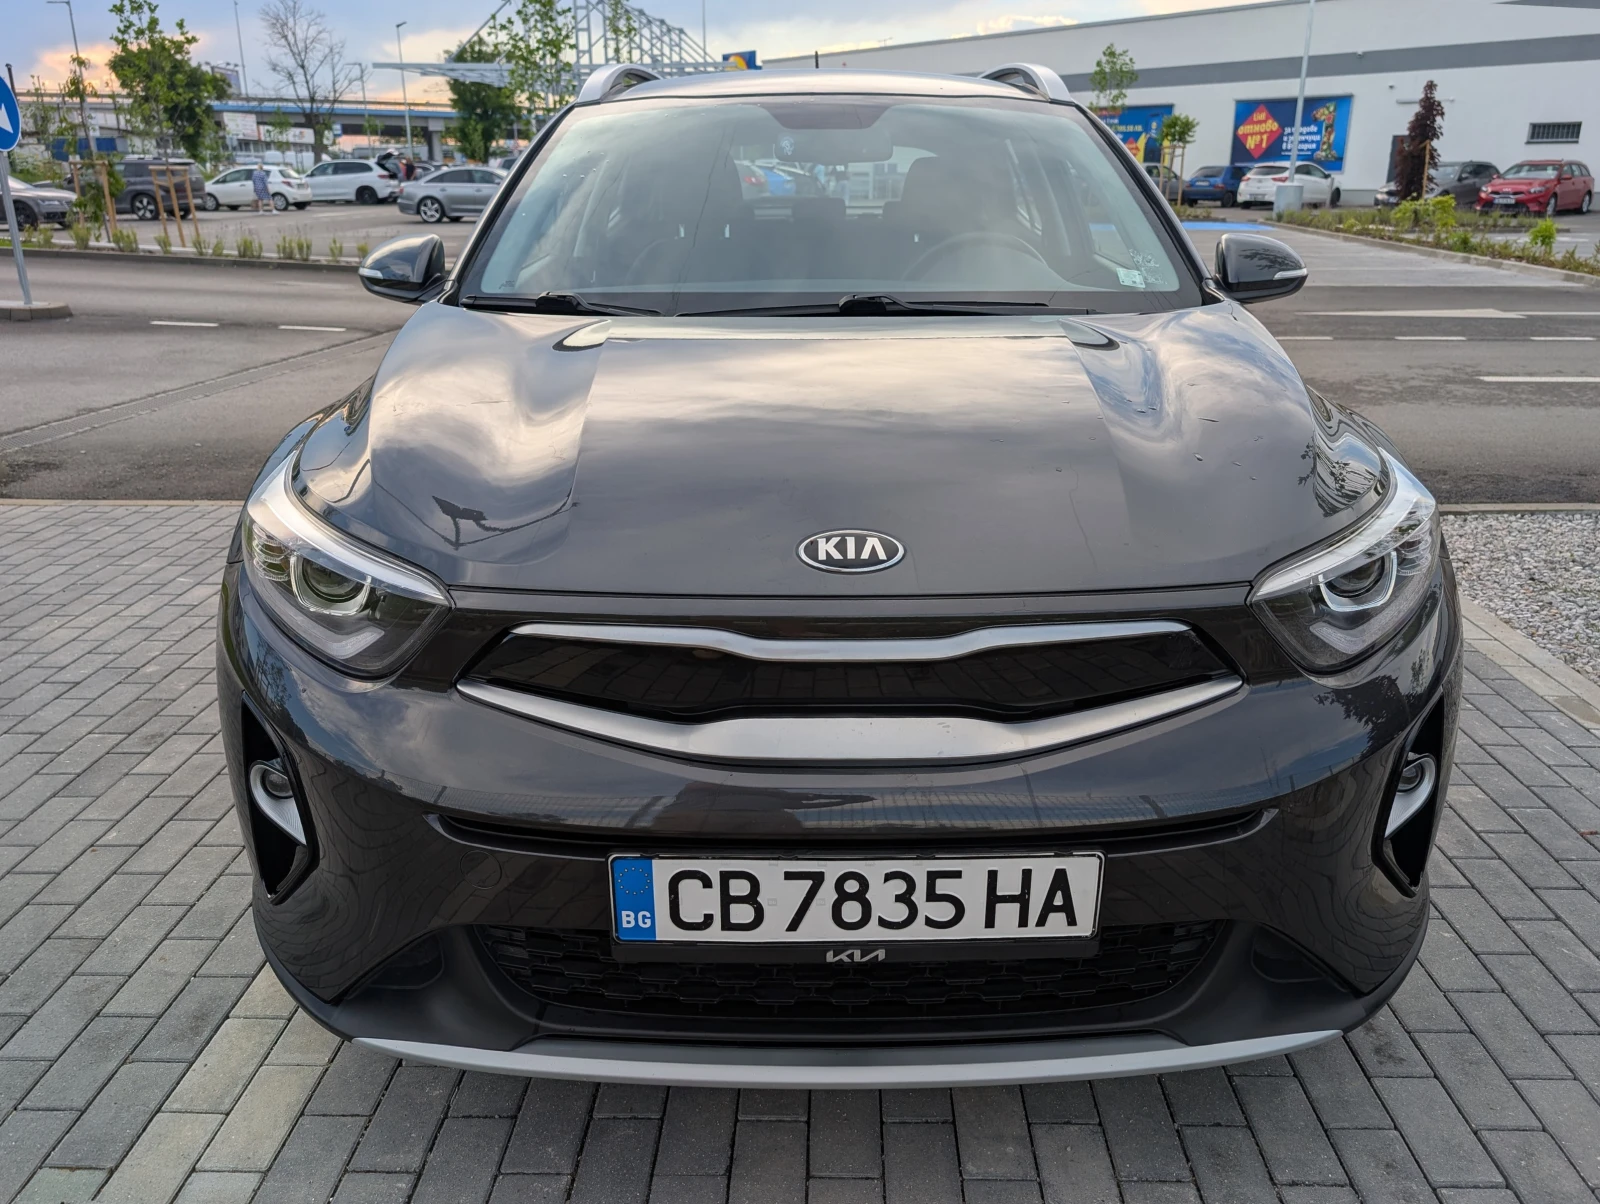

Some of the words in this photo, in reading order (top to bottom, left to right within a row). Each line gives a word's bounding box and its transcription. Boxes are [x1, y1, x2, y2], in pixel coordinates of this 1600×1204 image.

[1253, 112, 1266, 121] Lidl
[1238, 119, 1279, 135] отново
[816, 536, 888, 561] KIA
[668, 869, 765, 932] CB
[783, 869, 966, 932] 7835
[983, 867, 1078, 929] HA
[621, 910, 652, 928] BG
